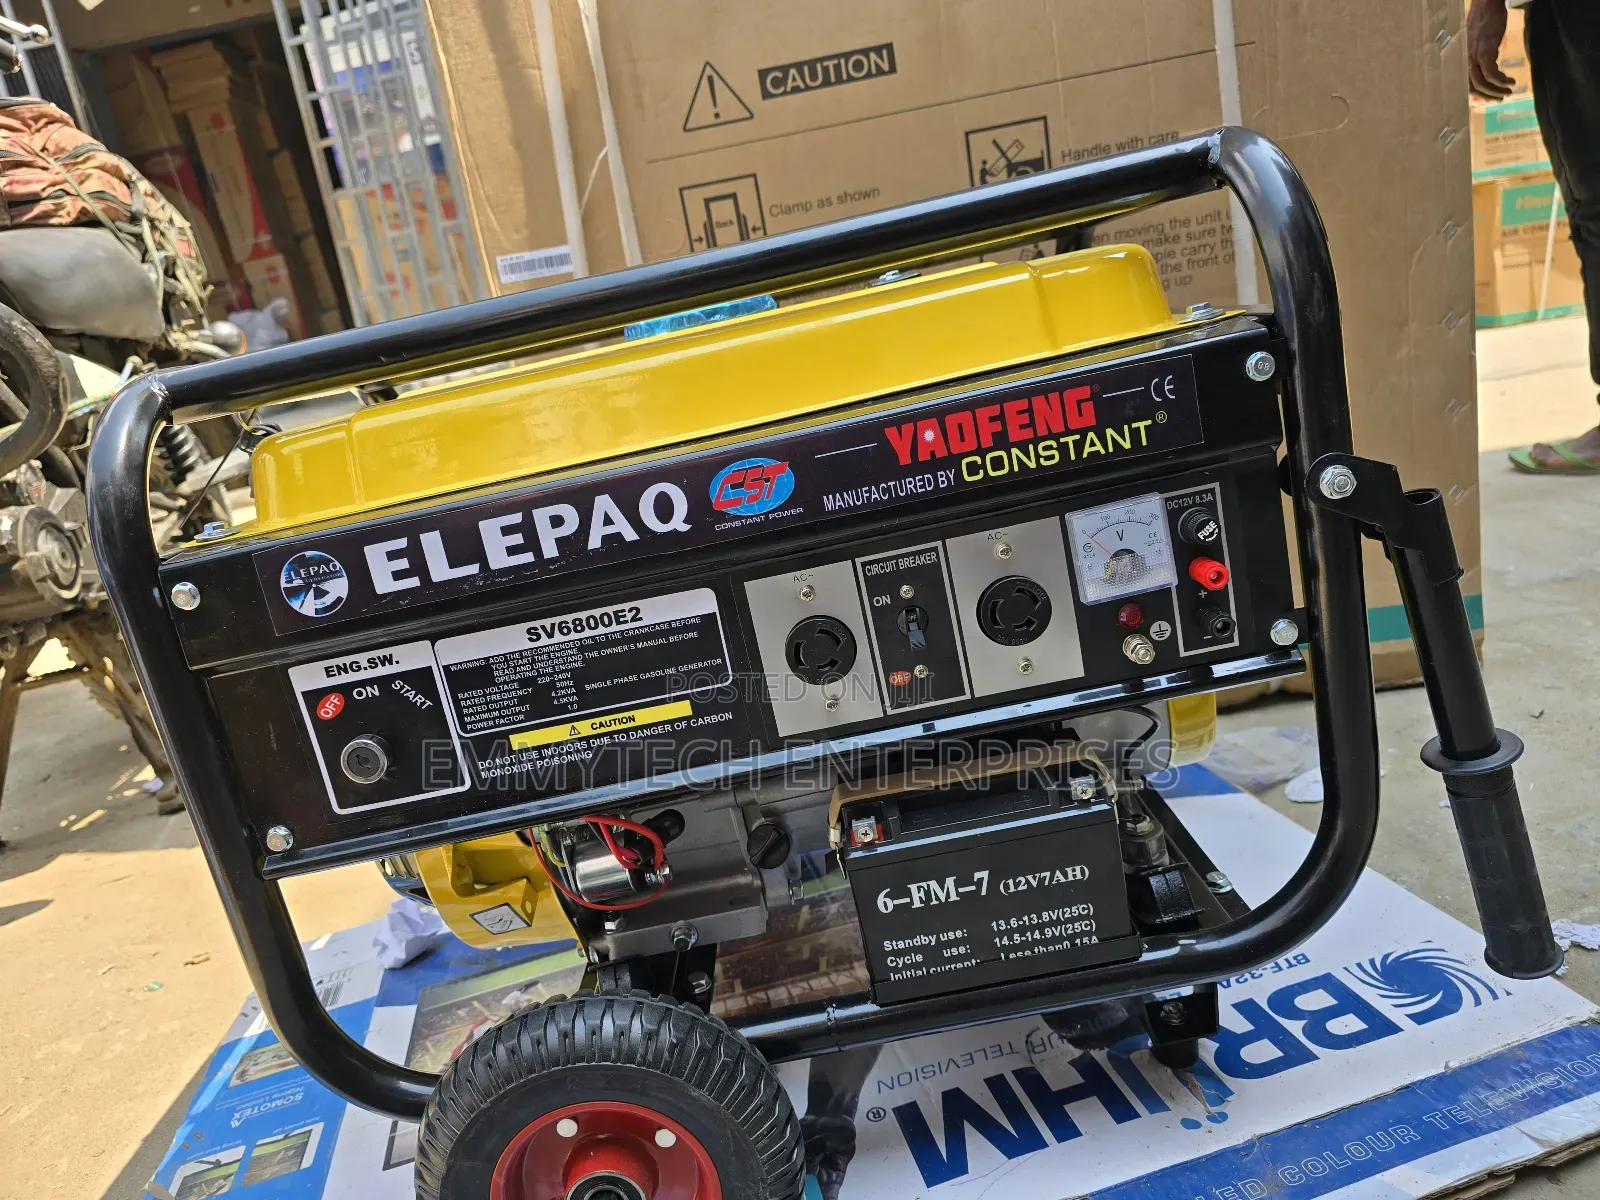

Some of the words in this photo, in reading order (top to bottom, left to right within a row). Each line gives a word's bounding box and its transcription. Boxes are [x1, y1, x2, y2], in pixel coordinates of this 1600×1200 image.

[765, 48, 890, 96] CAUTION
[1061, 143, 1112, 162] Handle
[1115, 134, 1144, 152] with
[1148, 130, 1179, 147] care
[769, 199, 813, 218] Clamp
[816, 196, 833, 210] as
[836, 186, 881, 206] shown
[715, 219, 734, 229] Back
[1114, 222, 1164, 241] moving
[1168, 216, 1191, 231] the
[1195, 209, 1222, 226] unit
[1142, 233, 1180, 249] make
[1185, 227, 1216, 243] sure
[1181, 241, 1217, 258] carry
[1160, 262, 1182, 276] the
[1186, 255, 1221, 270] front
[1175, 274, 1193, 288] up
[885, 385, 1097, 466] YAOFENG
[823, 476, 935, 512] MANUFACTURED
[938, 468, 956, 487] BY
[961, 419, 1153, 482] CONSTANT
[711, 461, 790, 513] CST
[1100, 513, 1111, 522] 100
[1124, 508, 1136, 516] 200
[1167, 497, 1193, 511] DC12V
[1195, 493, 1214, 505] 8.3A
[714, 514, 766, 532] CONSTANT
[769, 507, 804, 520] POWER
[1197, 520, 1217, 542] FUSE
[363, 482, 693, 596] ELEPAQ
[1116, 530, 1124, 542] V
[282, 560, 341, 585] ELEPAQ
[865, 562, 897, 576] CIRCUIT
[899, 552, 938, 570] BREAKER
[873, 595, 891, 607] ON
[526, 606, 643, 643] SV6800E2
[450, 659, 487, 672] WARNING:
[489, 656, 505, 664] ADD
[506, 652, 521, 661] THE
[522, 641, 580, 658] RECOMMENDED
[581, 638, 594, 646] OIL
[596, 635, 606, 643] TO
[608, 632, 622, 640] THE
[623, 624, 670, 637] CRANKCASE
[672, 617, 701, 628] BEFORE
[493, 668, 515, 678] READ
[516, 664, 532, 673] AND
[533, 655, 583, 670] UNDERSTAND
[584, 650, 600, 659] THE
[600, 643, 636, 656] OWNER'S
[637, 637, 669, 649] MANUAL
[669, 631, 699, 643] BEFORE
[324, 653, 400, 679] ENG.SW.
[491, 663, 508, 671] YOU
[509, 657, 532, 667] START
[534, 654, 550, 663] THE
[495, 670, 538, 684] OPERATING
[539, 667, 553, 675] THE
[555, 661, 586, 673] ENGINE.
[584, 679, 612, 691] SINGLE
[613, 674, 638, 685] PHASE
[640, 667, 677, 680] GASOLINE
[678, 658, 722, 672] GENERATOR
[458, 689, 483, 700] RATED
[485, 682, 520, 695] VOLTAGE
[889, 671, 911, 685] OFF
[319, 694, 341, 718] OFF
[352, 684, 380, 701] ON
[391, 679, 434, 711] START
[460, 697, 486, 708] RATED
[487, 687, 533, 702] FREQUENCY
[556, 680, 574, 689] 50Hz
[463, 705, 488, 716] RATED
[489, 698, 518, 710] OUTPUT
[551, 687, 577, 698] 4.2KVA
[464, 710, 500, 723] MAXIMUM
[501, 704, 530, 716] OUTPUT
[553, 695, 579, 705] 4.5KVA
[467, 720, 494, 731] POWER
[495, 714, 525, 725] FACTOR
[567, 703, 578, 711] 1.0
[590, 714, 636, 731] CAUTION
[478, 760, 493, 770] DO
[495, 755, 516, 766] NOT
[518, 751, 539, 762] USE
[541, 740, 588, 758] INDOORS
[590, 736, 612, 748] DUE
[613, 733, 627, 743] TO
[629, 724, 673, 740] DANGER
[674, 720, 689, 731] OF
[690, 711, 733, 727] CARBON
[481, 760, 534, 779] MONOXIDE
[537, 749, 593, 769] POISONING
[999, 864, 1090, 896] (12V7AH)
[884, 932, 937, 952] Standby
[939, 927, 968, 942] use:
[887, 952, 924, 968] Cycle
[943, 943, 971, 958] use:
[877, 1040, 1020, 1094] TELEVISION
[232, 1092, 304, 1121] SOMOTEX
[1278, 1124, 1421, 1186] COLOUR
